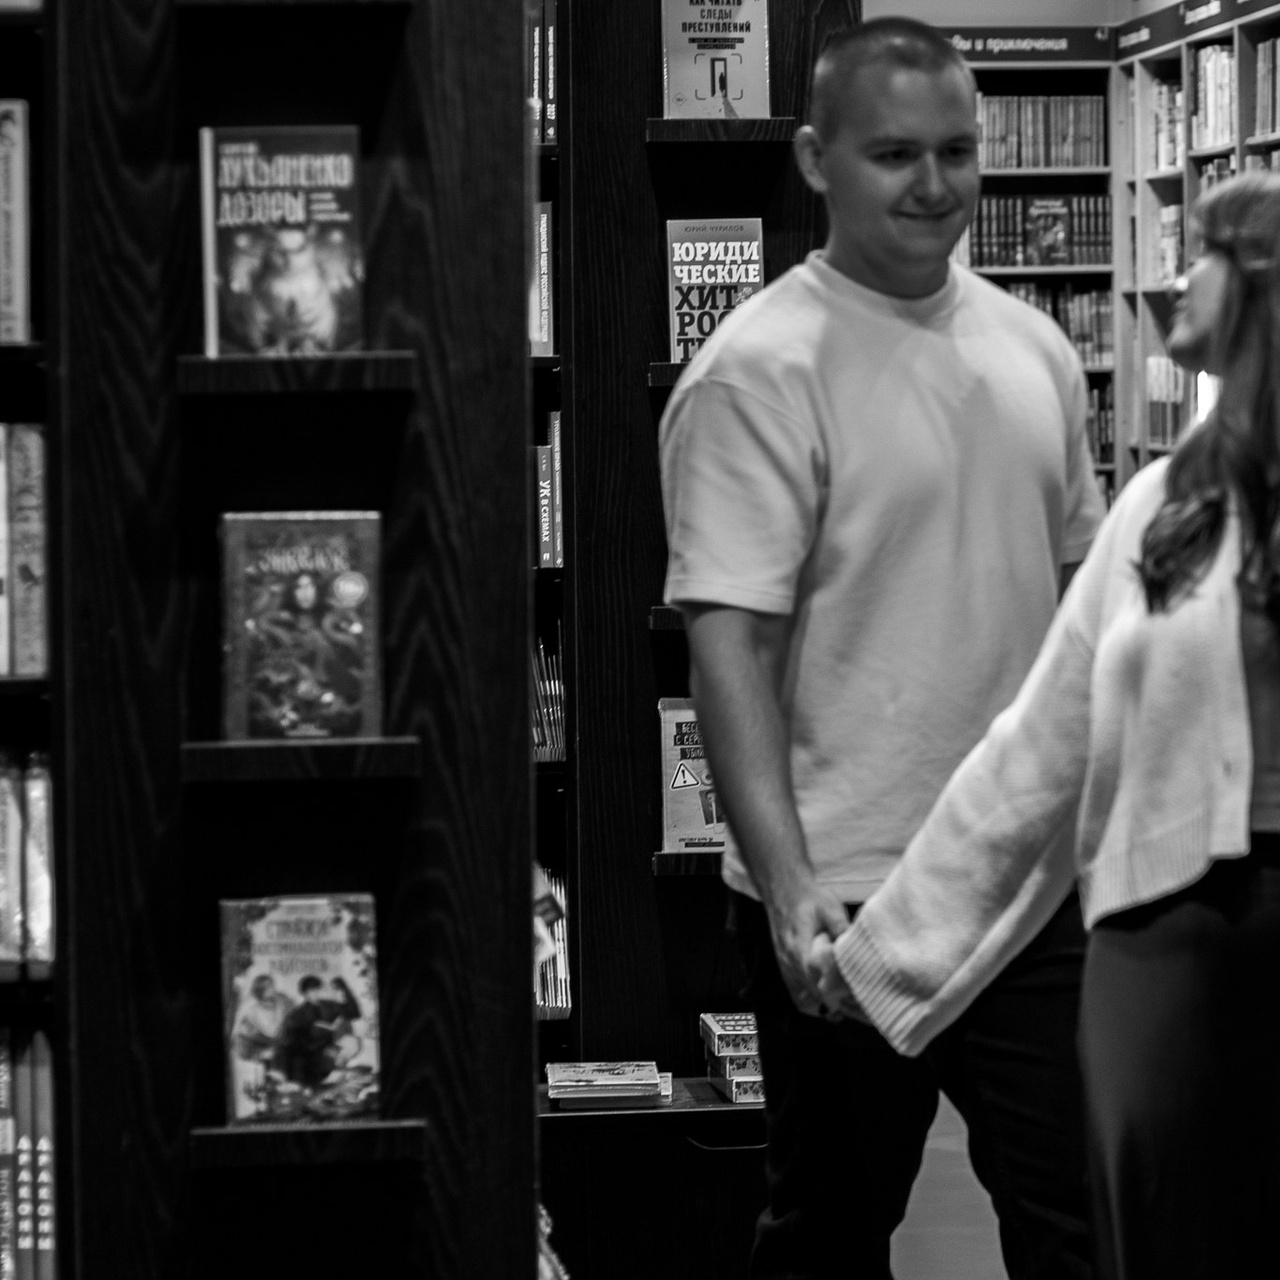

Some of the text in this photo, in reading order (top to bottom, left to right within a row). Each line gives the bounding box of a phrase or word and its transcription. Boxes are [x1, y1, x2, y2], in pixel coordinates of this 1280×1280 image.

[700, 8, 732, 20] СЛЕДЫ
[682, 20, 751, 33] ПРЕСТУПЛЕНИЙ
[684, 224, 744, 233] ЮРИЙ ЧУРИЛОВ
[672, 240, 760, 265] ЮРИДИ
[673, 264, 760, 284] ЧЕСКИЕ
[674, 285, 738, 311] ХИТ
[676, 337, 706, 362] Т
[540, 479, 551, 498] УК
[541, 506, 550, 542] СХЕМАХ
